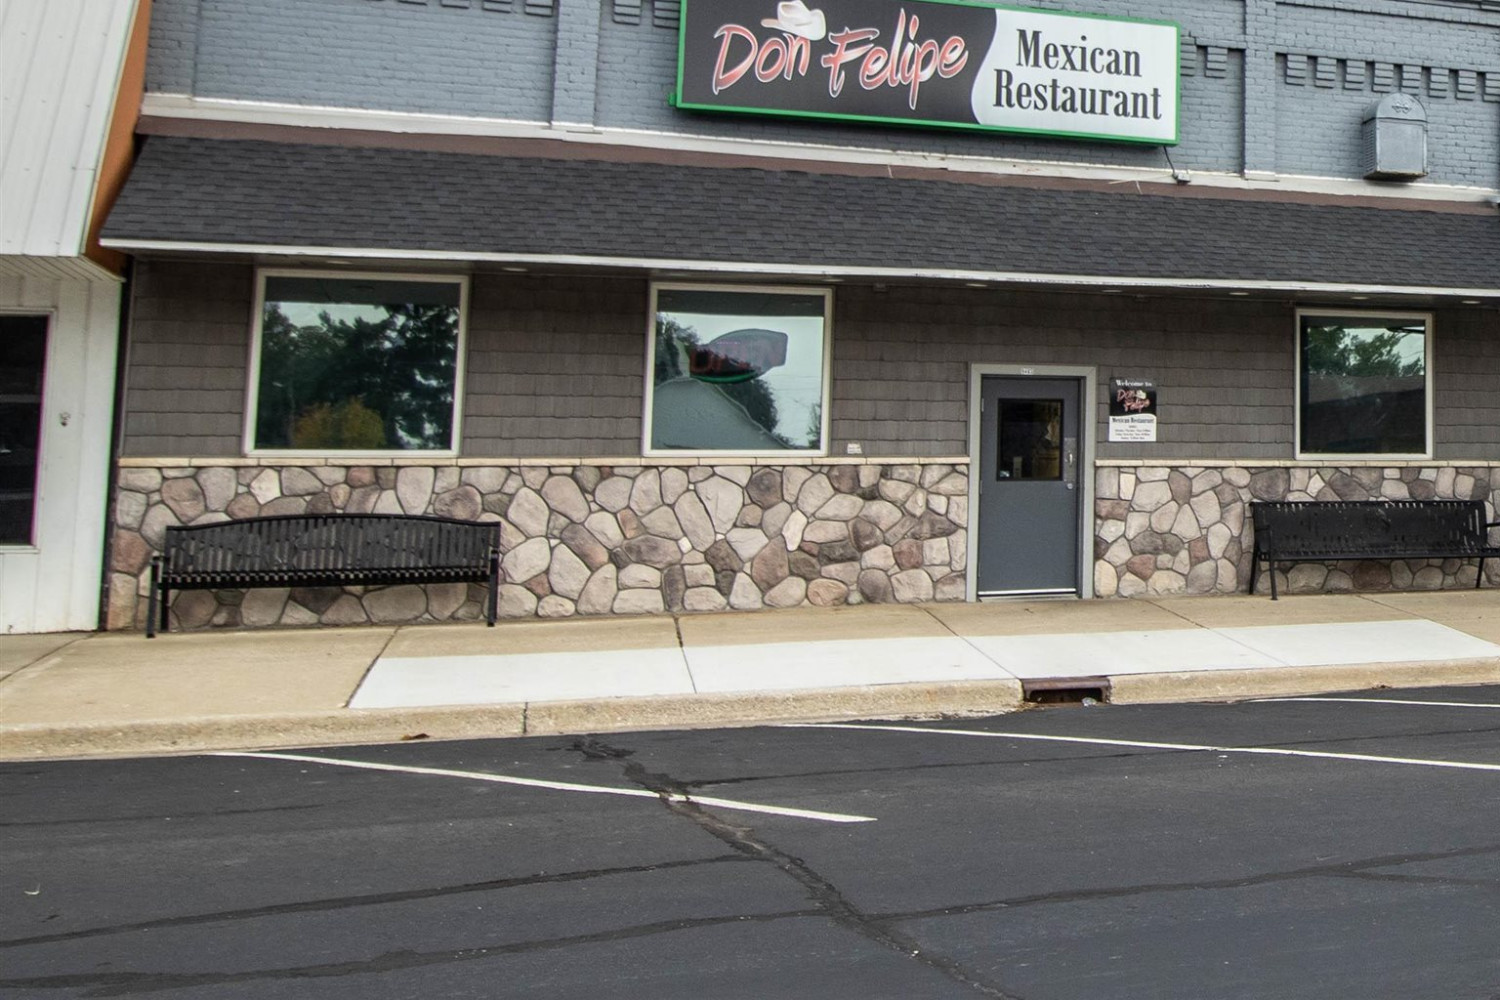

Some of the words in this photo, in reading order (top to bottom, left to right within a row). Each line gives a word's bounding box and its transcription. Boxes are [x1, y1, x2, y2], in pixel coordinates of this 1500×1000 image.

[712, 23, 810, 97] Don
[821, 7, 969, 111] Felipe
[1016, 28, 1143, 77] Mexican
[993, 68, 1163, 121] Restaurant
